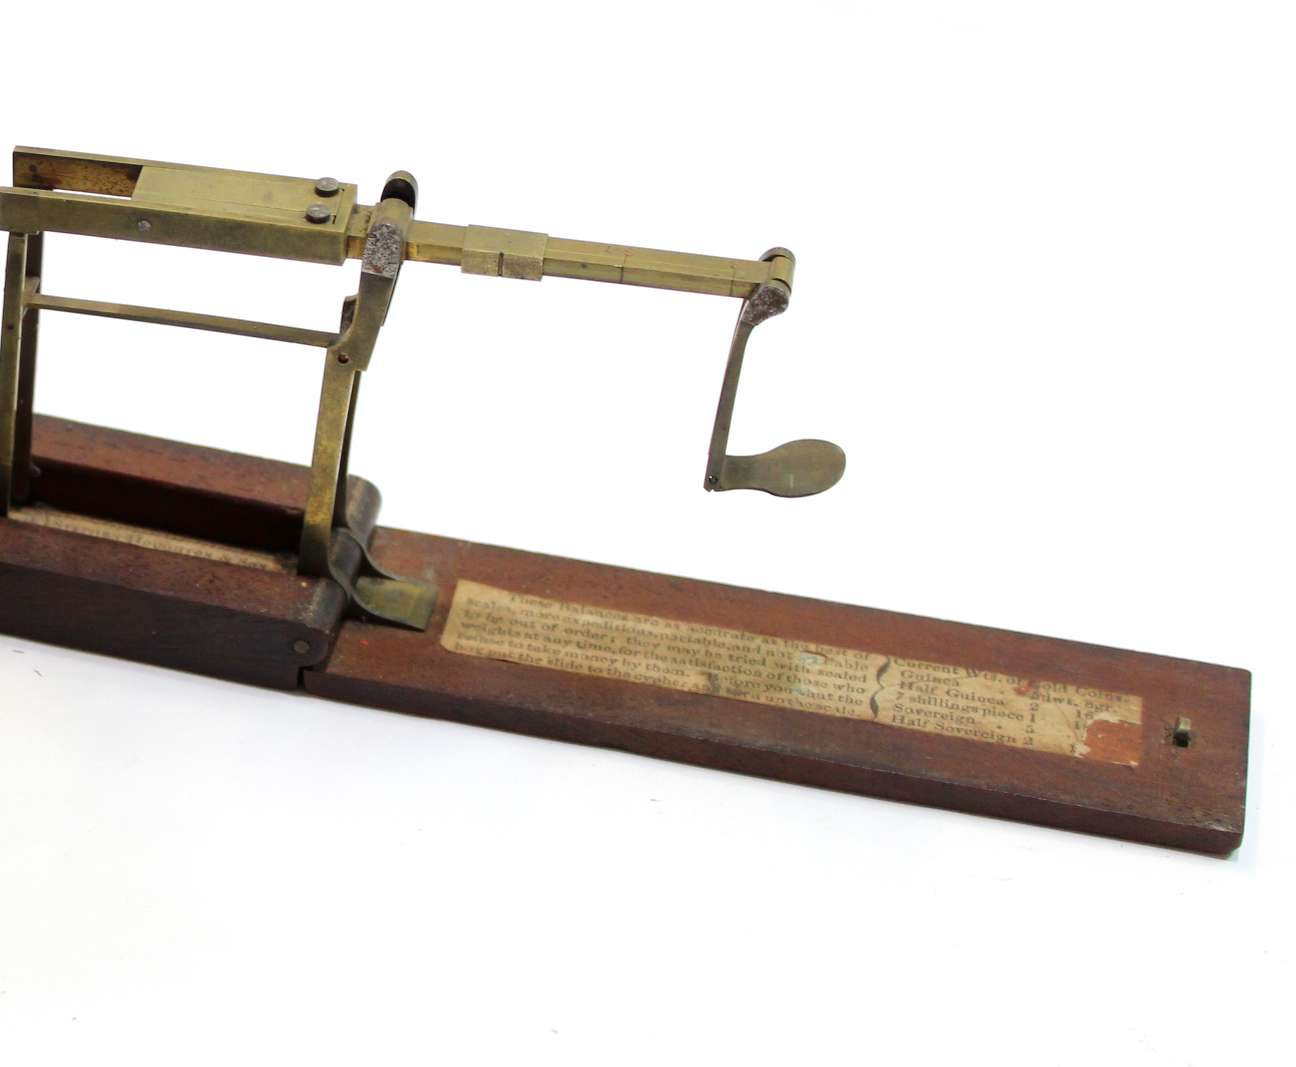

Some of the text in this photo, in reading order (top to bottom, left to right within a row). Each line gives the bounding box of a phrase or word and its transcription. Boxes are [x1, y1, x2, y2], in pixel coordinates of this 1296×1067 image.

[510, 591, 552, 608] These
[634, 614, 659, 627] are
[784, 638, 808, 650] the
[521, 607, 559, 622] more
[732, 640, 761, 655] and
[766, 647, 792, 660] not
[509, 615, 535, 628] out
[626, 635, 660, 651] they
[666, 643, 699, 657] may
[728, 651, 765, 667] tried
[774, 658, 810, 674] with
[817, 664, 867, 684] sealed
[543, 634, 572, 649] any
[617, 644, 641, 657] for
[643, 649, 667, 662] the
[670, 652, 762, 678] satisfaction
[786, 671, 828, 689] those
[833, 679, 866, 695] who
[893, 655, 959, 676] Current
[965, 668, 1002, 682] Wts.
[488, 646, 515, 660] put
[518, 651, 543, 665] the
[546, 655, 583, 672] slide
[606, 666, 631, 679] the
[692, 679, 721, 694] an
[527, 641, 561, 656] take
[565, 649, 618, 668] money
[645, 661, 689, 678] them.
[707, 671, 760, 691] efore
[764, 681, 792, 697] you
[838, 692, 863, 706] the
[900, 668, 960, 687] Guinea
[899, 678, 937, 695] Half
[945, 686, 1004, 706] Guinea
[909, 692, 979, 716] shillings
[982, 704, 1024, 723] piece
[891, 712, 930, 729] Half
[934, 719, 1016, 745] Sovereign
[893, 701, 975, 726] Sovereign
